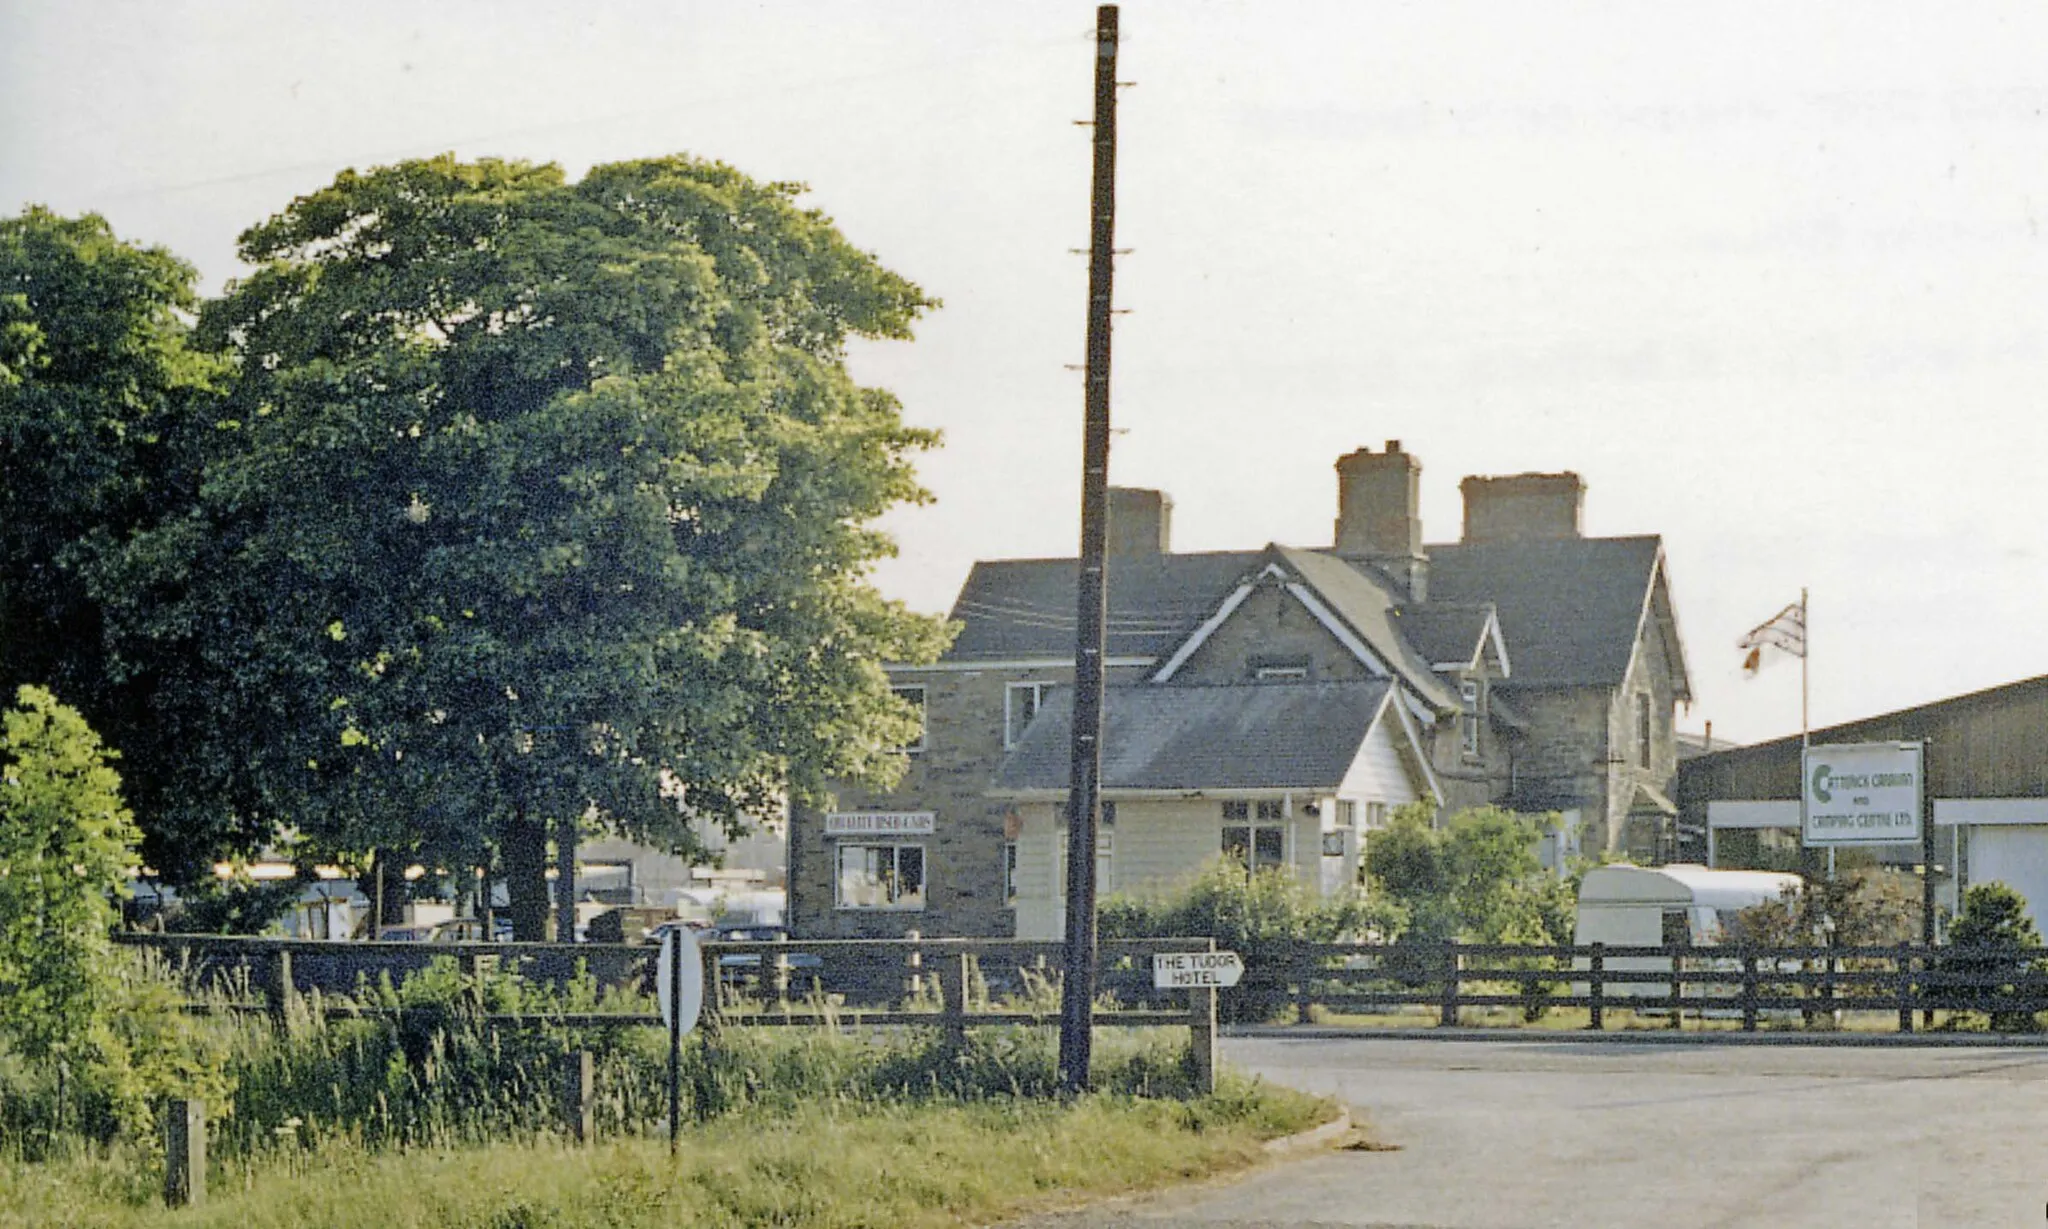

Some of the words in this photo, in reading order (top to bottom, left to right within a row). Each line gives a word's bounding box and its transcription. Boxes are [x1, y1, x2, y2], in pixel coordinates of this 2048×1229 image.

[1157, 956, 1186, 969] THE
[1189, 955, 1236, 969] TUDOR
[1171, 971, 1221, 984] HOTEL
